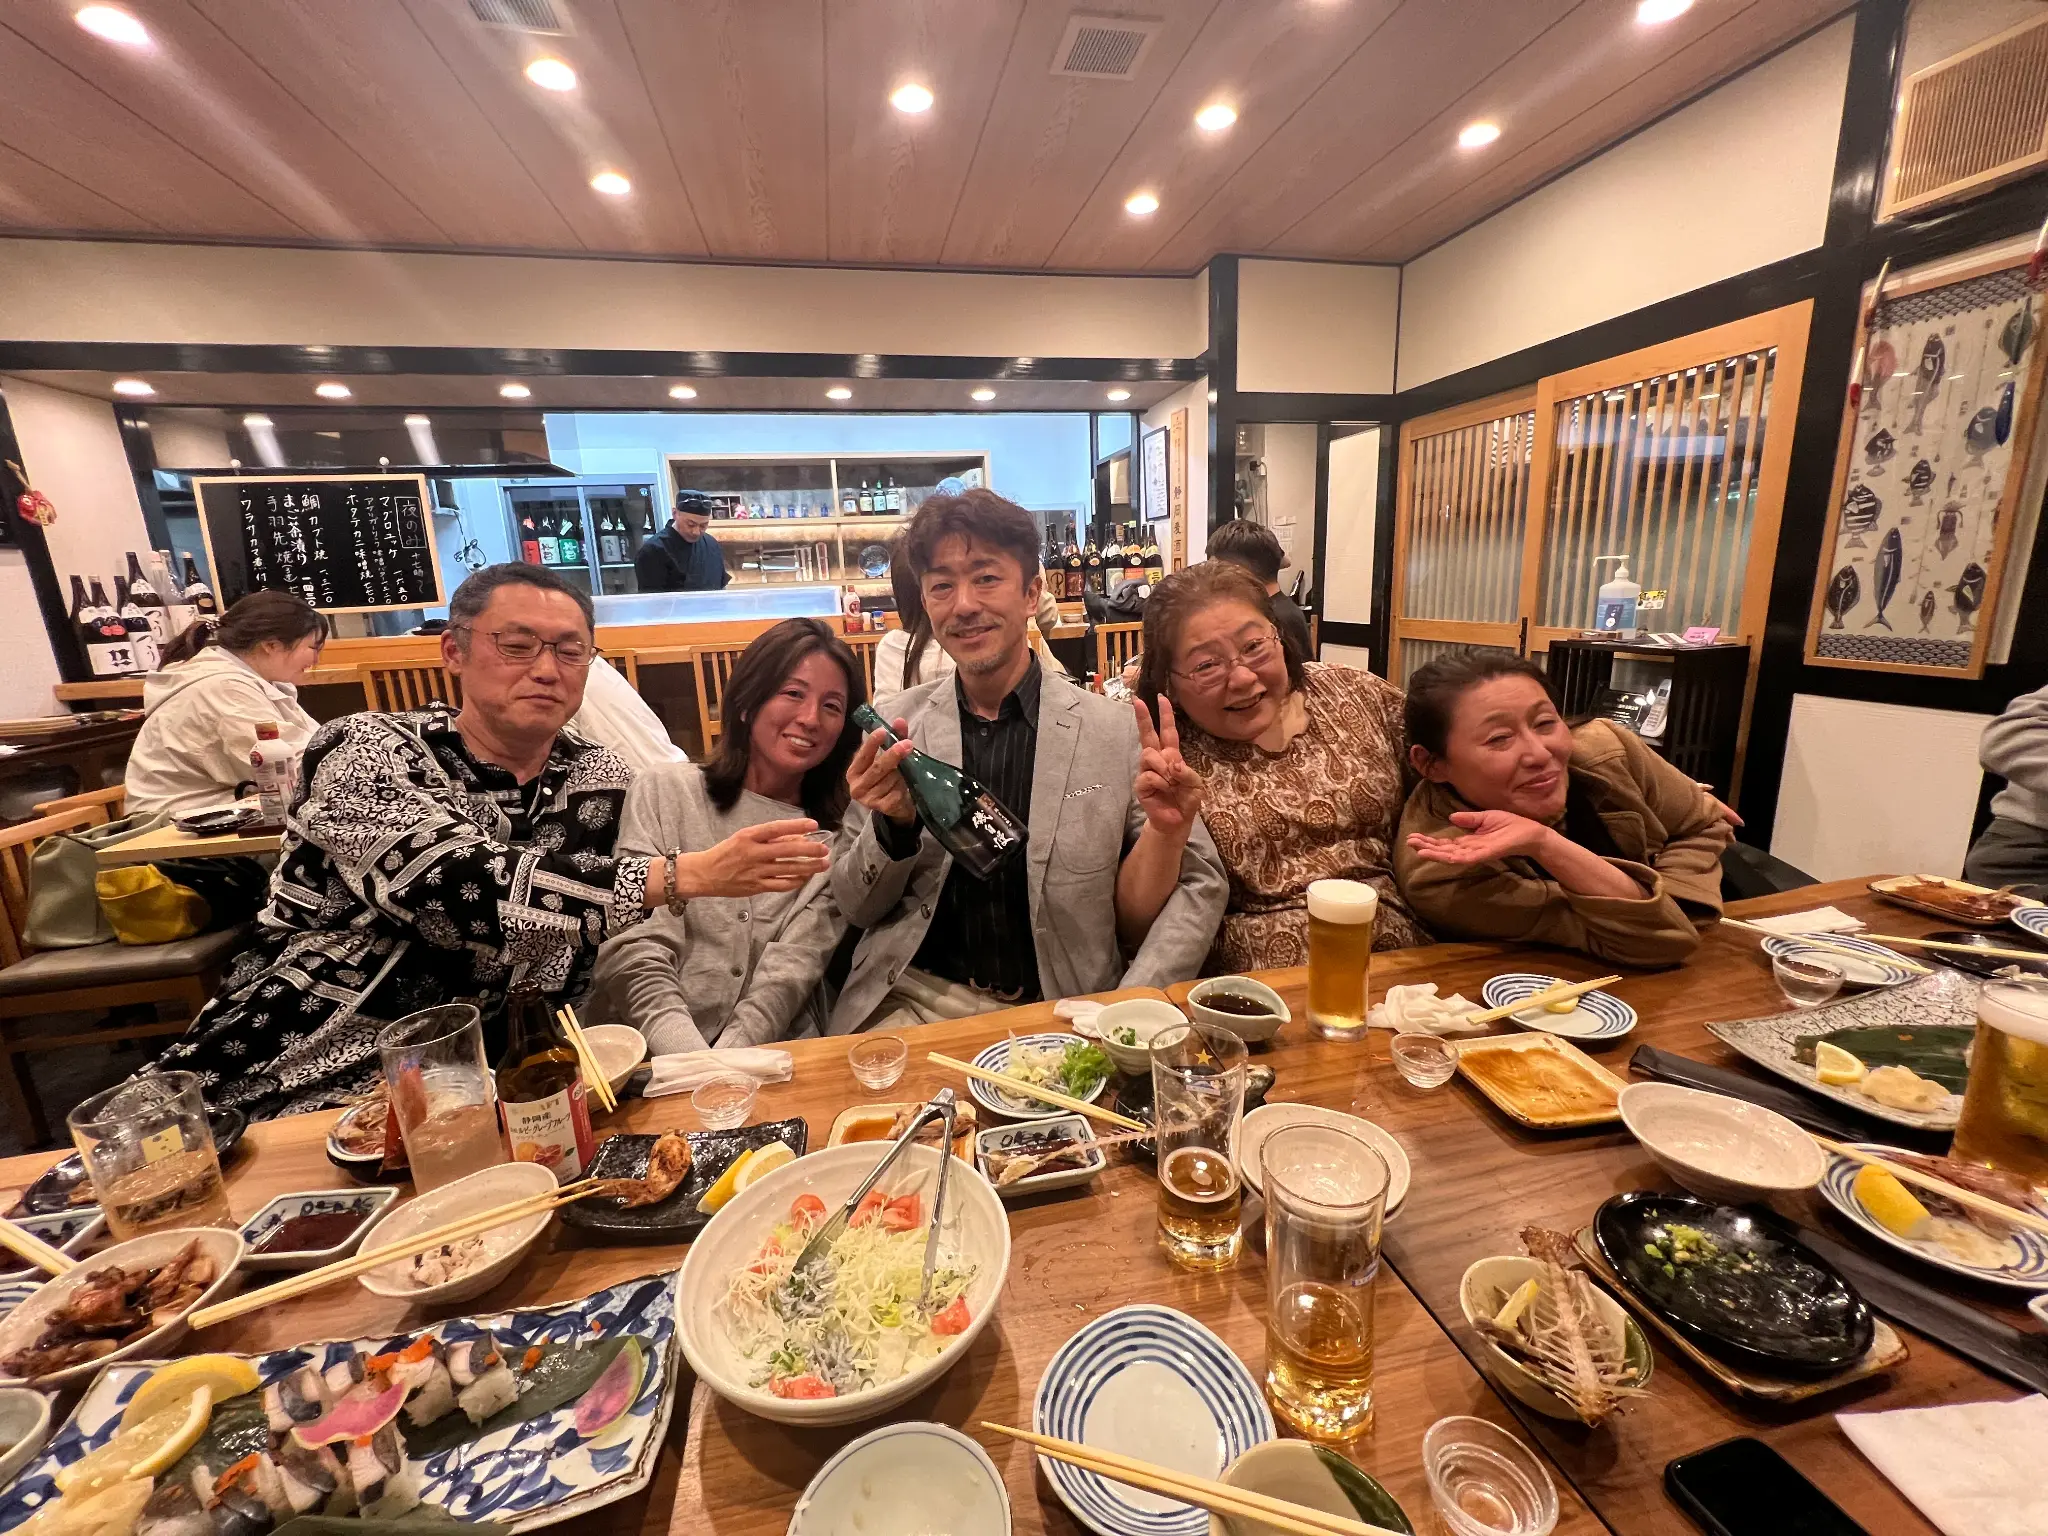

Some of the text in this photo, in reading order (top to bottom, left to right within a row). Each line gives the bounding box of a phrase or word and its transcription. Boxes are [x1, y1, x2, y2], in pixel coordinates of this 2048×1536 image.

[379, 496, 398, 559] マグロユッケ
[402, 500, 419, 547] 夜のみ
[971, 809, 1014, 850] 磯自慢
[521, 1111, 552, 1125] 静岡産
